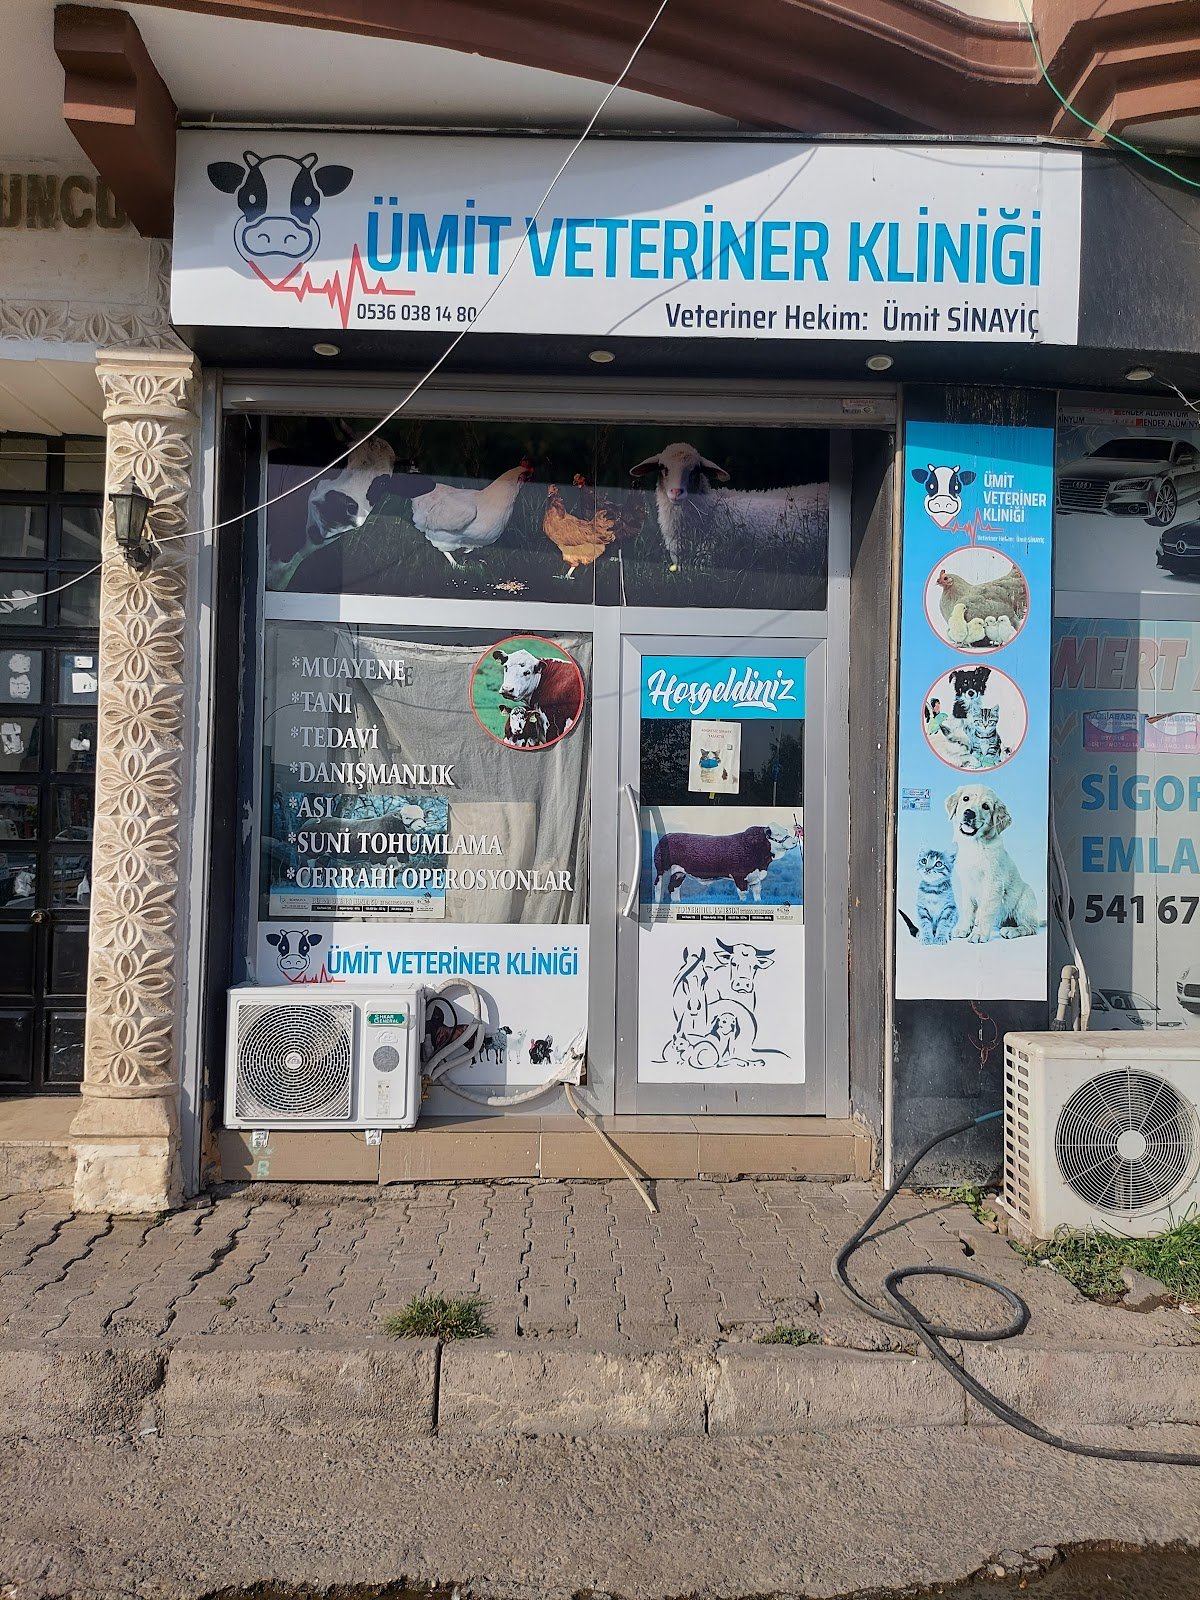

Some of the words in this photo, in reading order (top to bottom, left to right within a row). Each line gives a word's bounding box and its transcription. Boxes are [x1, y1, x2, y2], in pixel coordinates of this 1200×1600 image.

[367, 196, 512, 275] ÜMİT
[525, 204, 829, 281] VETERİNER
[848, 206, 1042, 287] KLİNİĞİ
[356, 303, 396, 320] 0536
[401, 305, 431, 322] 038
[435, 306, 452, 322] 14
[456, 306, 477, 323] 80
[666, 302, 777, 329] Veteriner
[784, 304, 868, 331] Hekim:
[883, 299, 940, 332] Ümit
[946, 301, 1039, 339] SİNAYİÇ
[983, 470, 1015, 488] ÜMİT
[983, 489, 1047, 507] VETERİNER
[983, 505, 1025, 523] KLİNİĞİ
[1052, 637, 1189, 690] MERT
[358, 831, 503, 856] TOHUMLAMA
[1081, 836, 1200, 874] EMLA
[402, 866, 574, 892] OPEROSYONLAR
[1084, 894, 1145, 924] 541
[1157, 895, 1200, 925] 67
[327, 945, 382, 975] ÜMİT
[386, 945, 500, 976] VETERİNER
[506, 946, 578, 976] KLİNİĞİ
